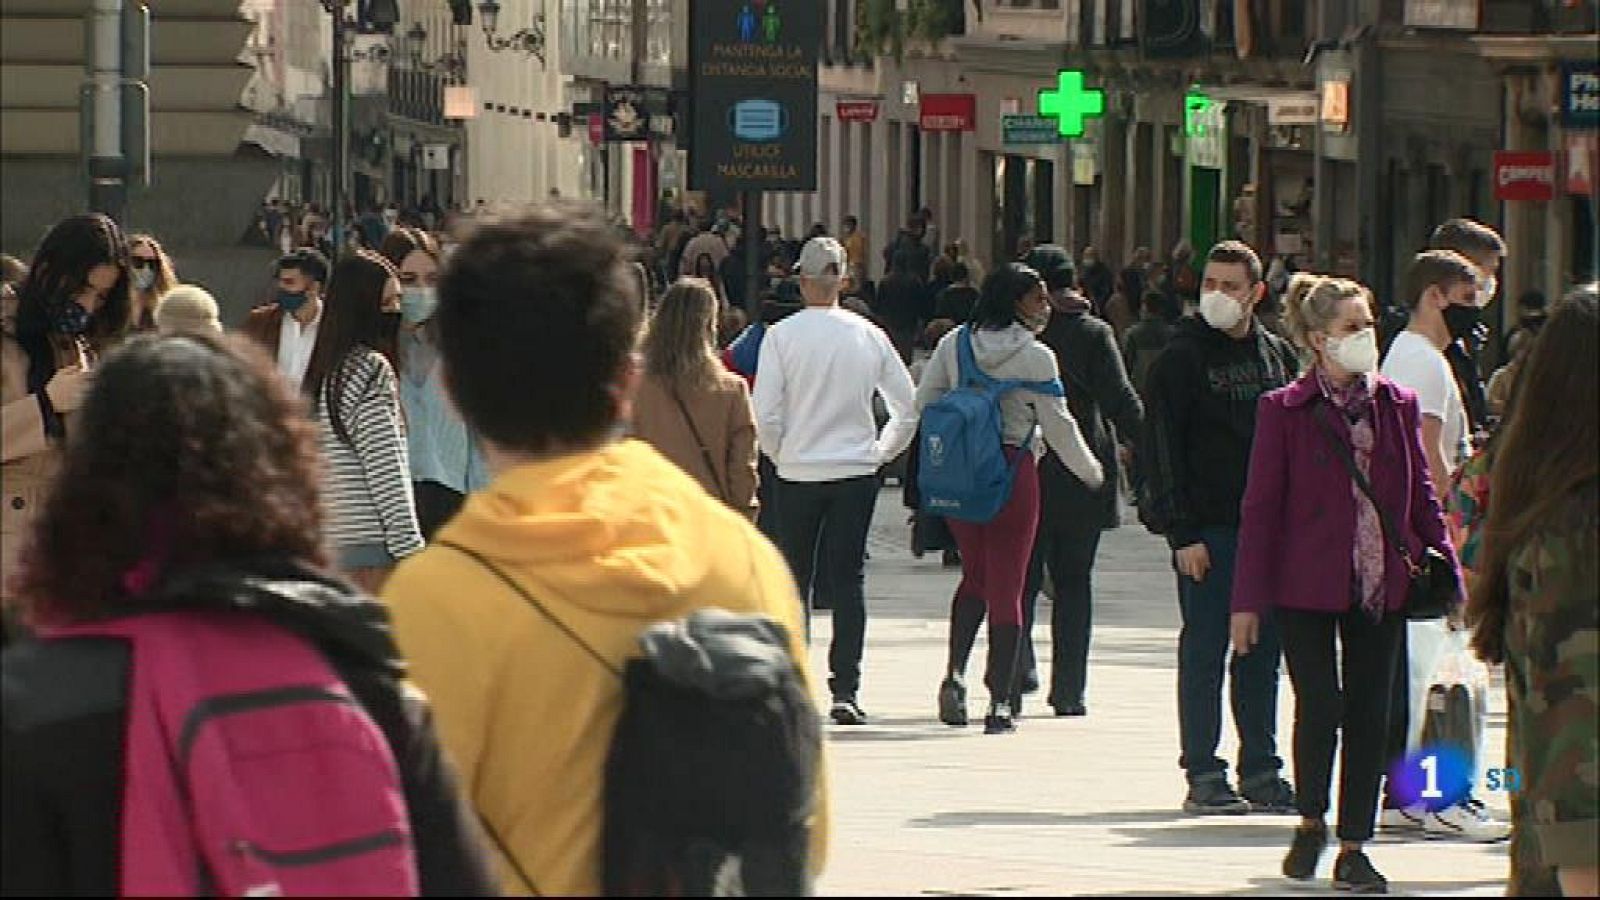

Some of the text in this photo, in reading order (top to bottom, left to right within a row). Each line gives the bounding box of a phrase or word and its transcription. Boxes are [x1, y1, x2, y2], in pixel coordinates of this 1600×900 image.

[712, 43, 803, 58] MANTENGA LA
[702, 62, 813, 77] DISTANCIA SOCIAL
[732, 144, 783, 158] UTILICE
[716, 162, 799, 178] MASCARILLA
